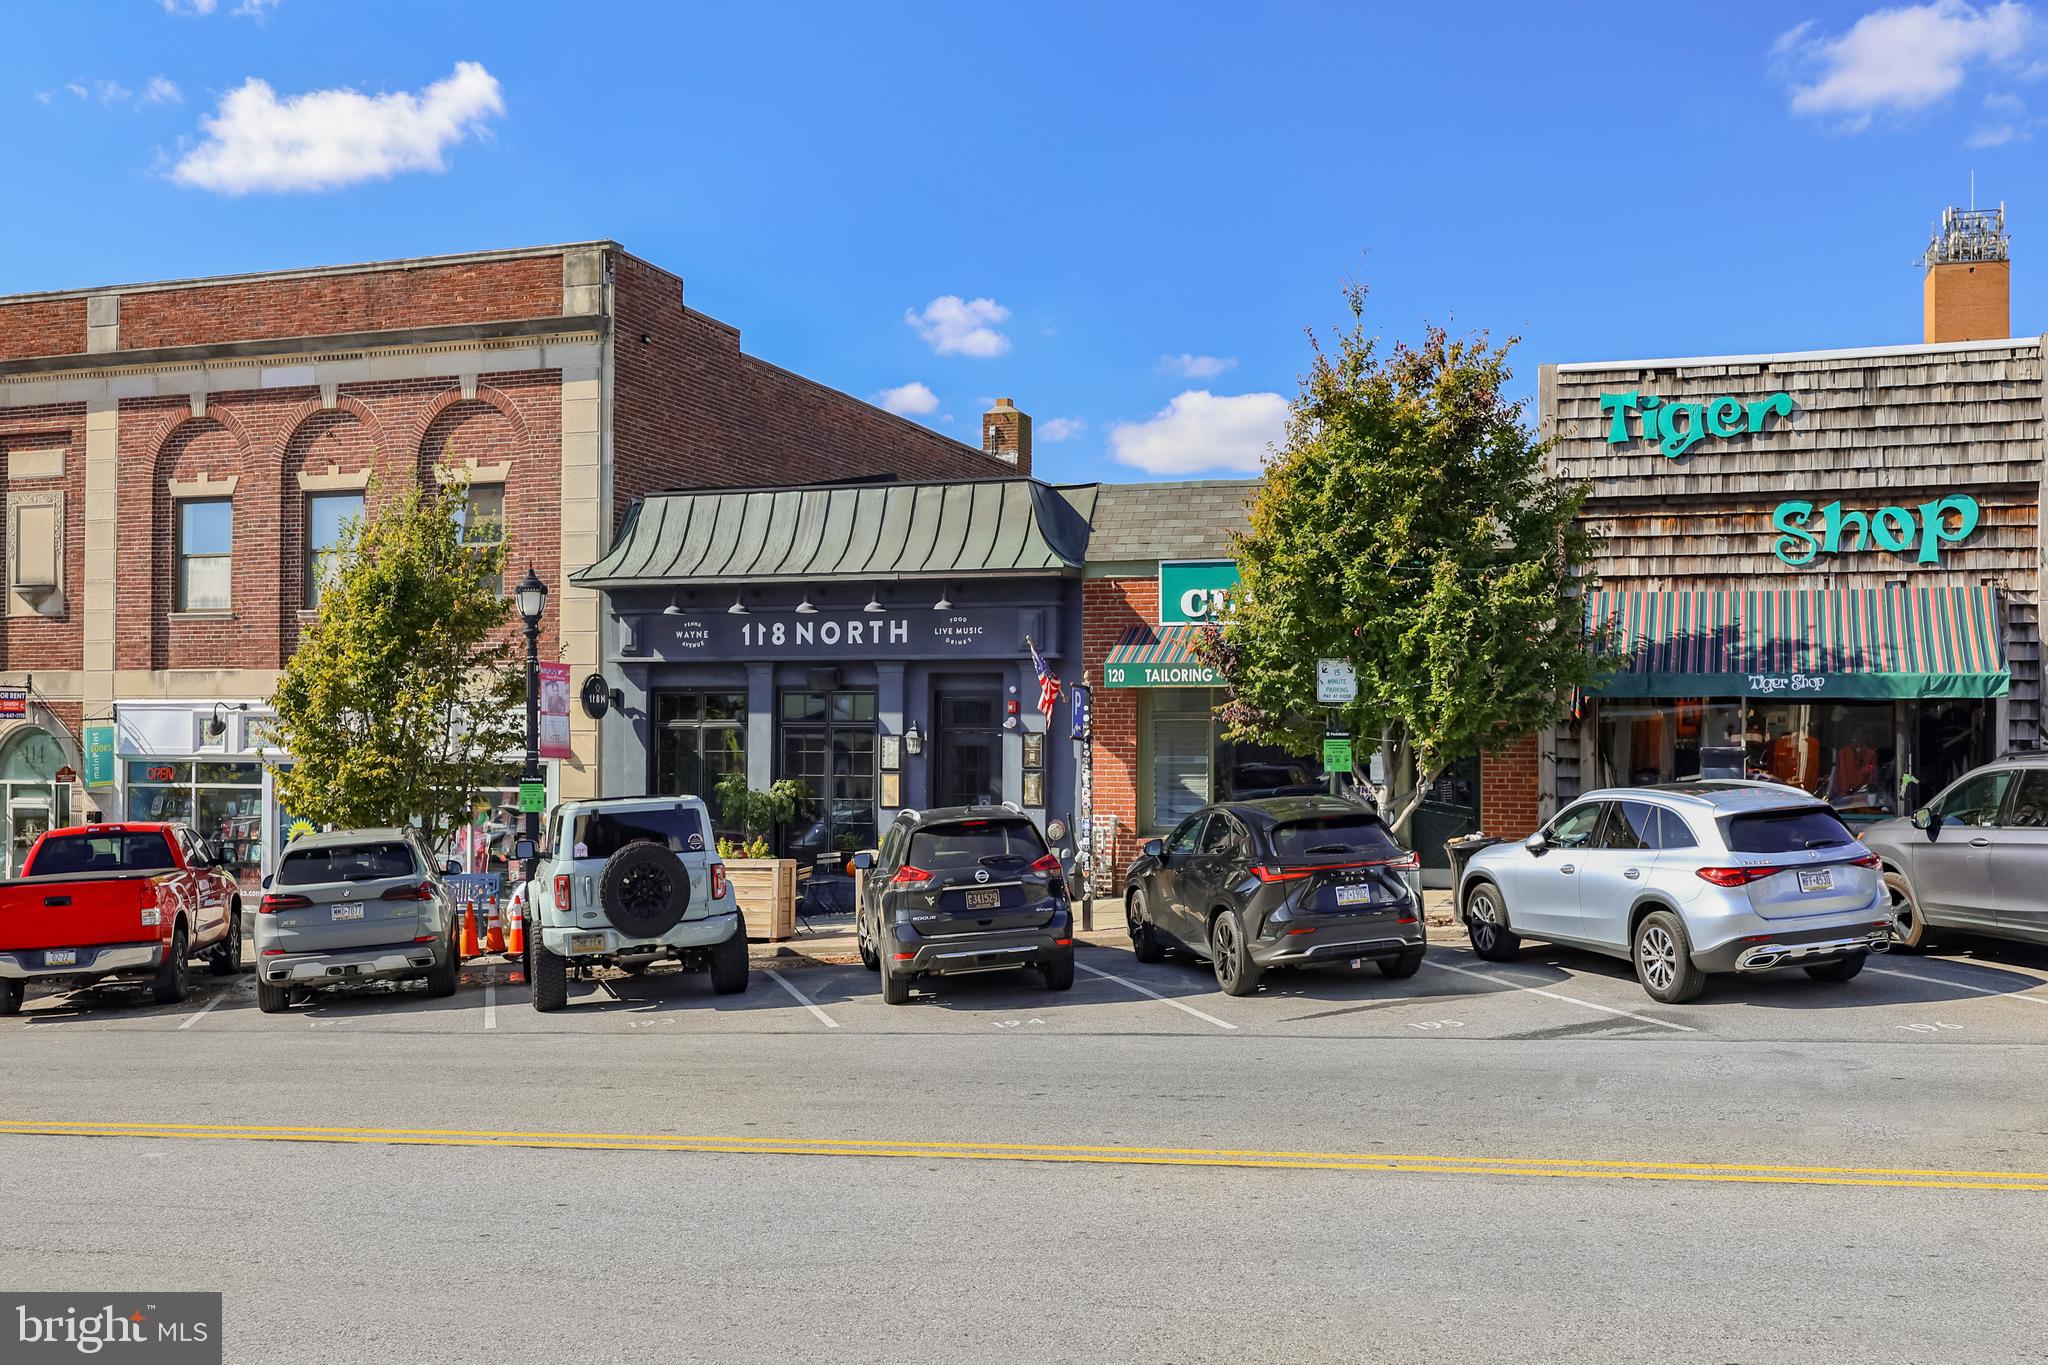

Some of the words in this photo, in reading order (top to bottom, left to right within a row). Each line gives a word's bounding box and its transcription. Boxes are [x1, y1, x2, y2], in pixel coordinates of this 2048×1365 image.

[1600, 390, 1793, 458] Tiger
[1772, 494, 1979, 566] Shop
[675, 630, 709, 639] WAYNE
[796, 620, 908, 645] NORTH
[934, 627, 953, 635] LIVE
[955, 627, 983, 635] MUSIC
[681, 640, 705, 649] AVENUE
[945, 637, 972, 646] DRINKS
[1107, 668, 1125, 683] 120
[1145, 668, 1213, 682] TAILORING
[1748, 674, 1788, 693] Tiger
[1791, 673, 1825, 691] Shop
[1075, 691, 1082, 715] P
[90, 744, 112, 753] BOOKS
[146, 768, 175, 780] OPEN
[1408, 1019, 1464, 1030] 195
